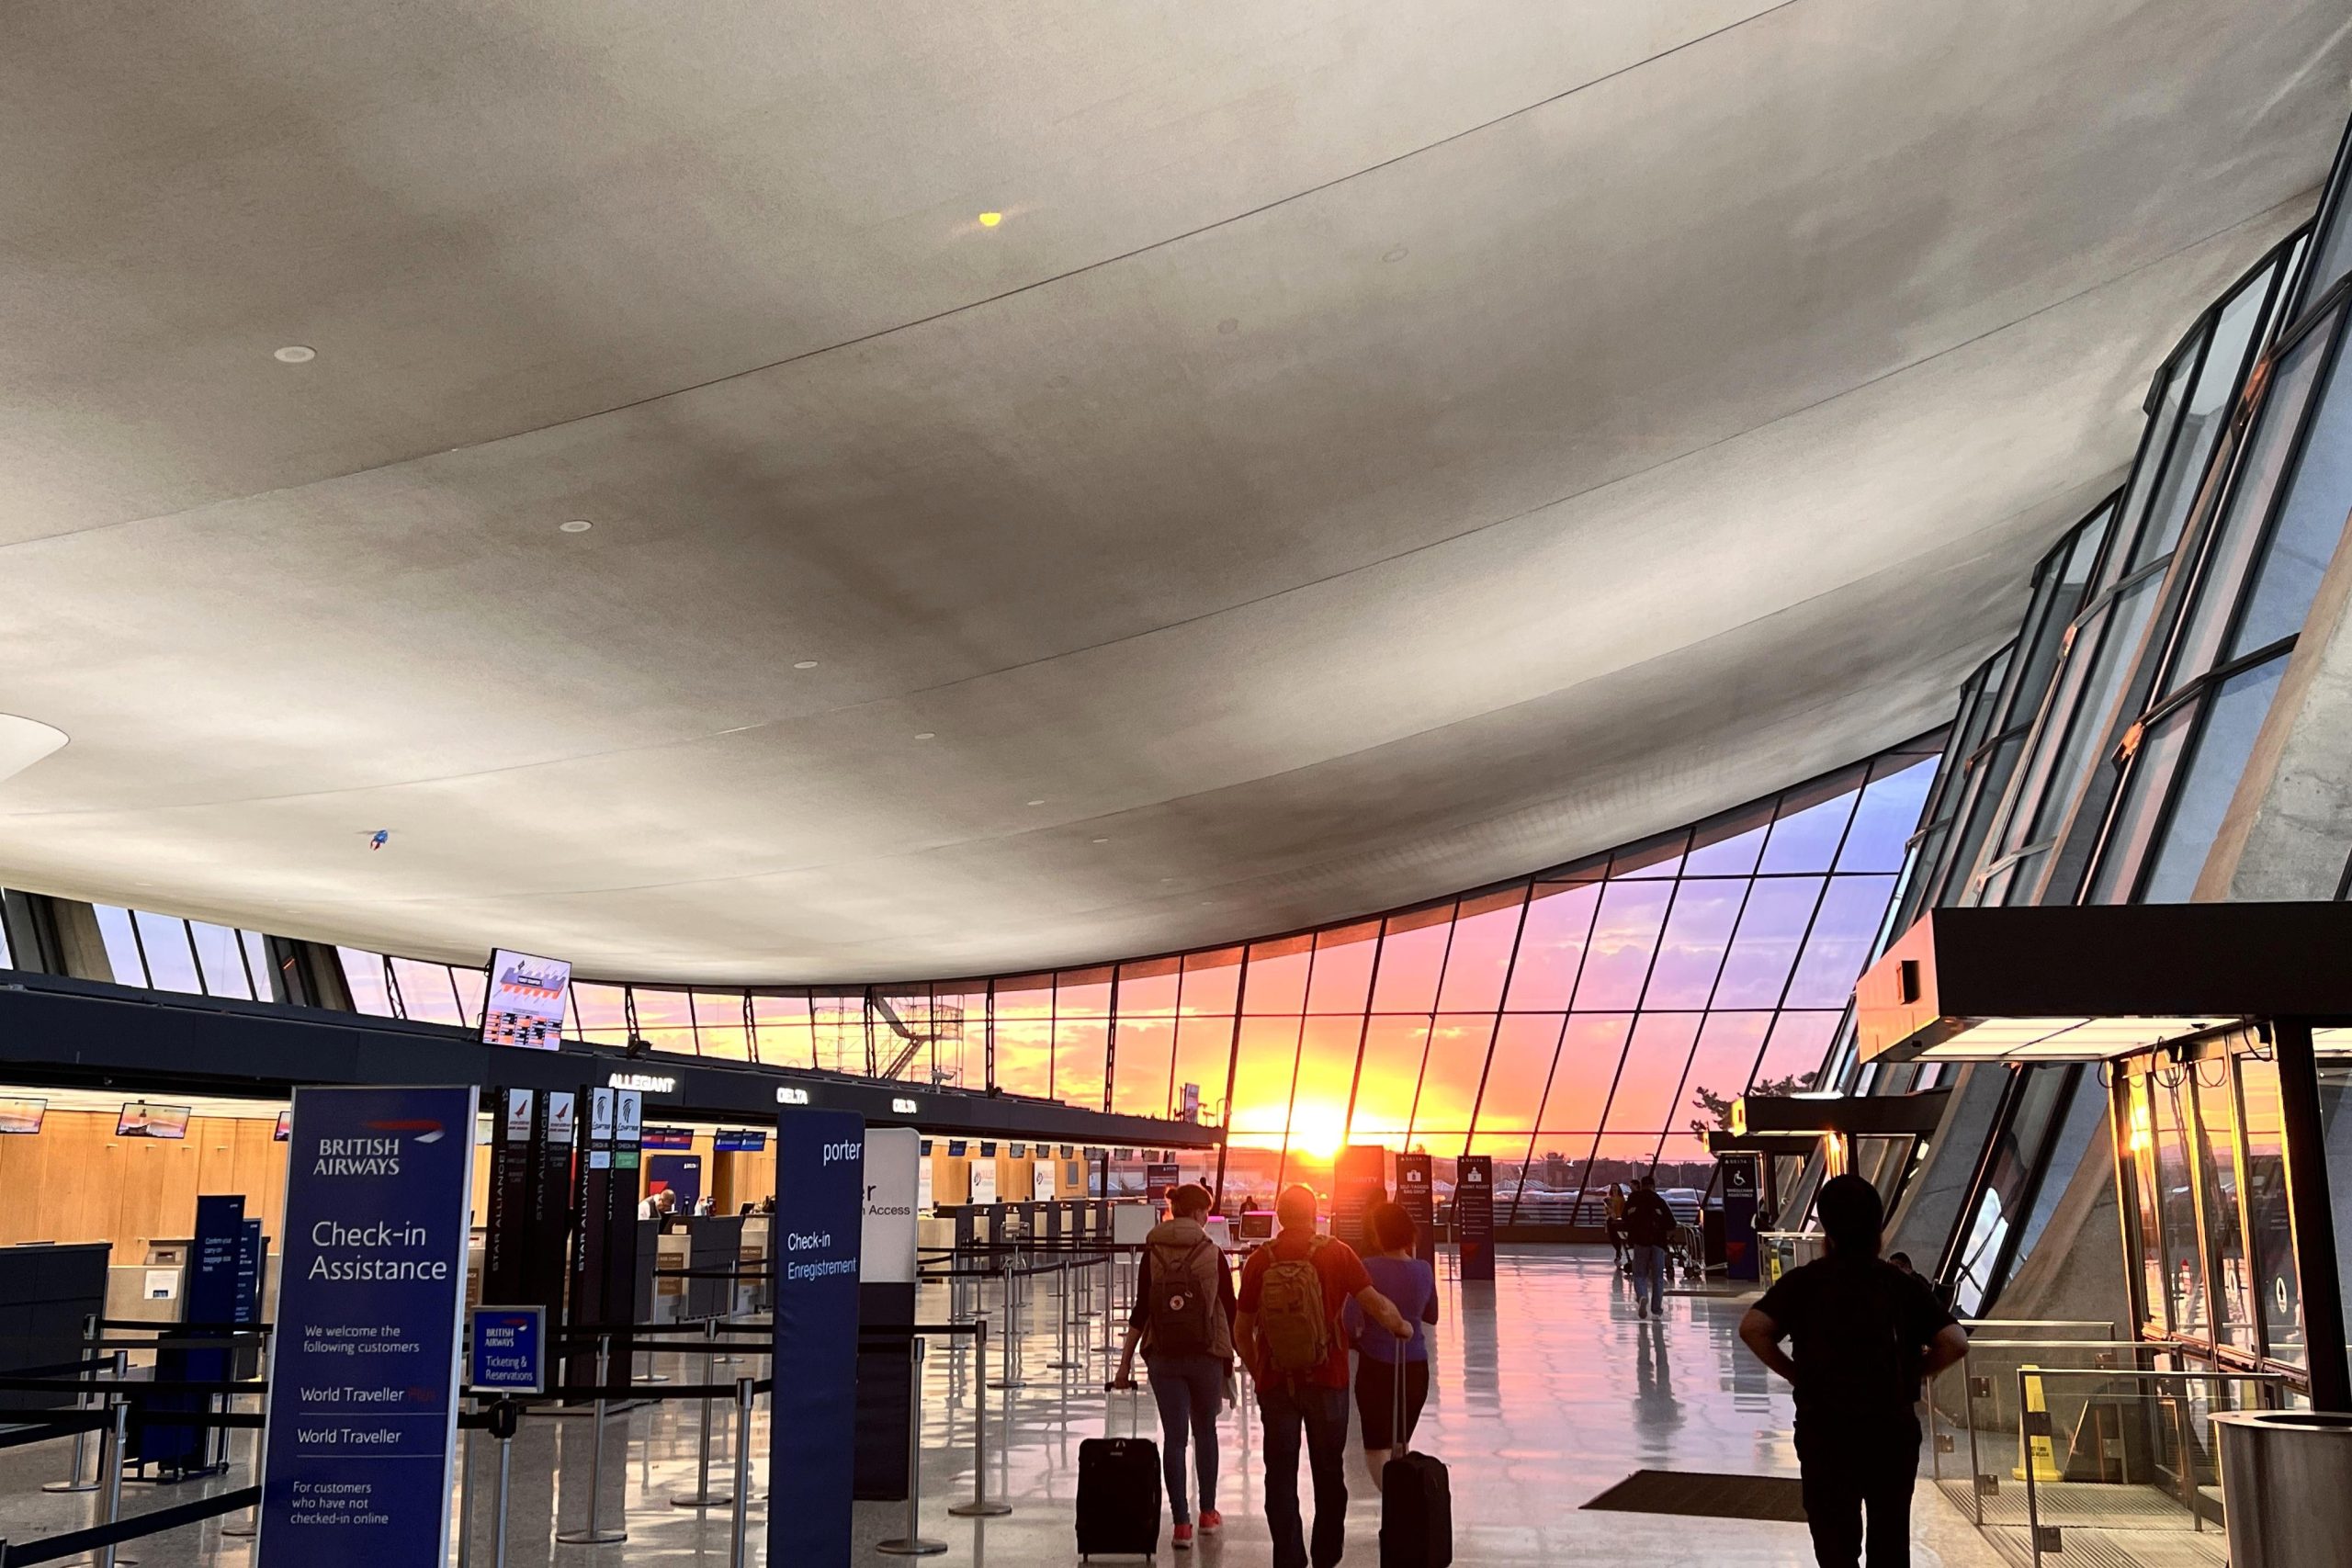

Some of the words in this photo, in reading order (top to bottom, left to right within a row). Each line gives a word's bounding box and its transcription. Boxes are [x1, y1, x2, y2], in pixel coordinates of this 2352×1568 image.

[608, 1073, 676, 1094] ALLEGIANT
[776, 1087, 808, 1105] DELTA
[892, 1099, 917, 1114] DELTA
[320, 1139, 399, 1155] BRITISH
[824, 1140, 861, 1166] porter
[313, 1158, 399, 1175] AIRWAYS
[495, 1154, 506, 1228] ALLIANCE
[581, 1154, 590, 1228] ALLIANCE
[869, 1204, 910, 1215] Access
[312, 1221, 425, 1246] Check-in
[788, 1231, 830, 1250] Check-in
[309, 1255, 447, 1280] Assistance
[788, 1258, 855, 1280] Enregistrement
[305, 1325, 322, 1337] We
[326, 1325, 377, 1337] welcome
[381, 1325, 400, 1337] the
[486, 1328, 514, 1337] BRITISH
[304, 1340, 355, 1355] following
[358, 1343, 419, 1352] customers
[485, 1337, 514, 1348] AIRWAYS
[486, 1356, 520, 1370] Ticketing
[520, 1355, 527, 1368] &
[485, 1369, 534, 1382] Reservations
[301, 1387, 340, 1401] World
[344, 1387, 404, 1401] Traveller
[298, 1429, 336, 1443] World
[341, 1429, 401, 1443] Traveller
[293, 1482, 311, 1493] For
[314, 1484, 371, 1493] customers
[292, 1497, 315, 1507] who
[320, 1497, 345, 1508] have
[349, 1499, 368, 1508] not
[290, 1512, 349, 1524] checked-in
[354, 1513, 389, 1524] online
